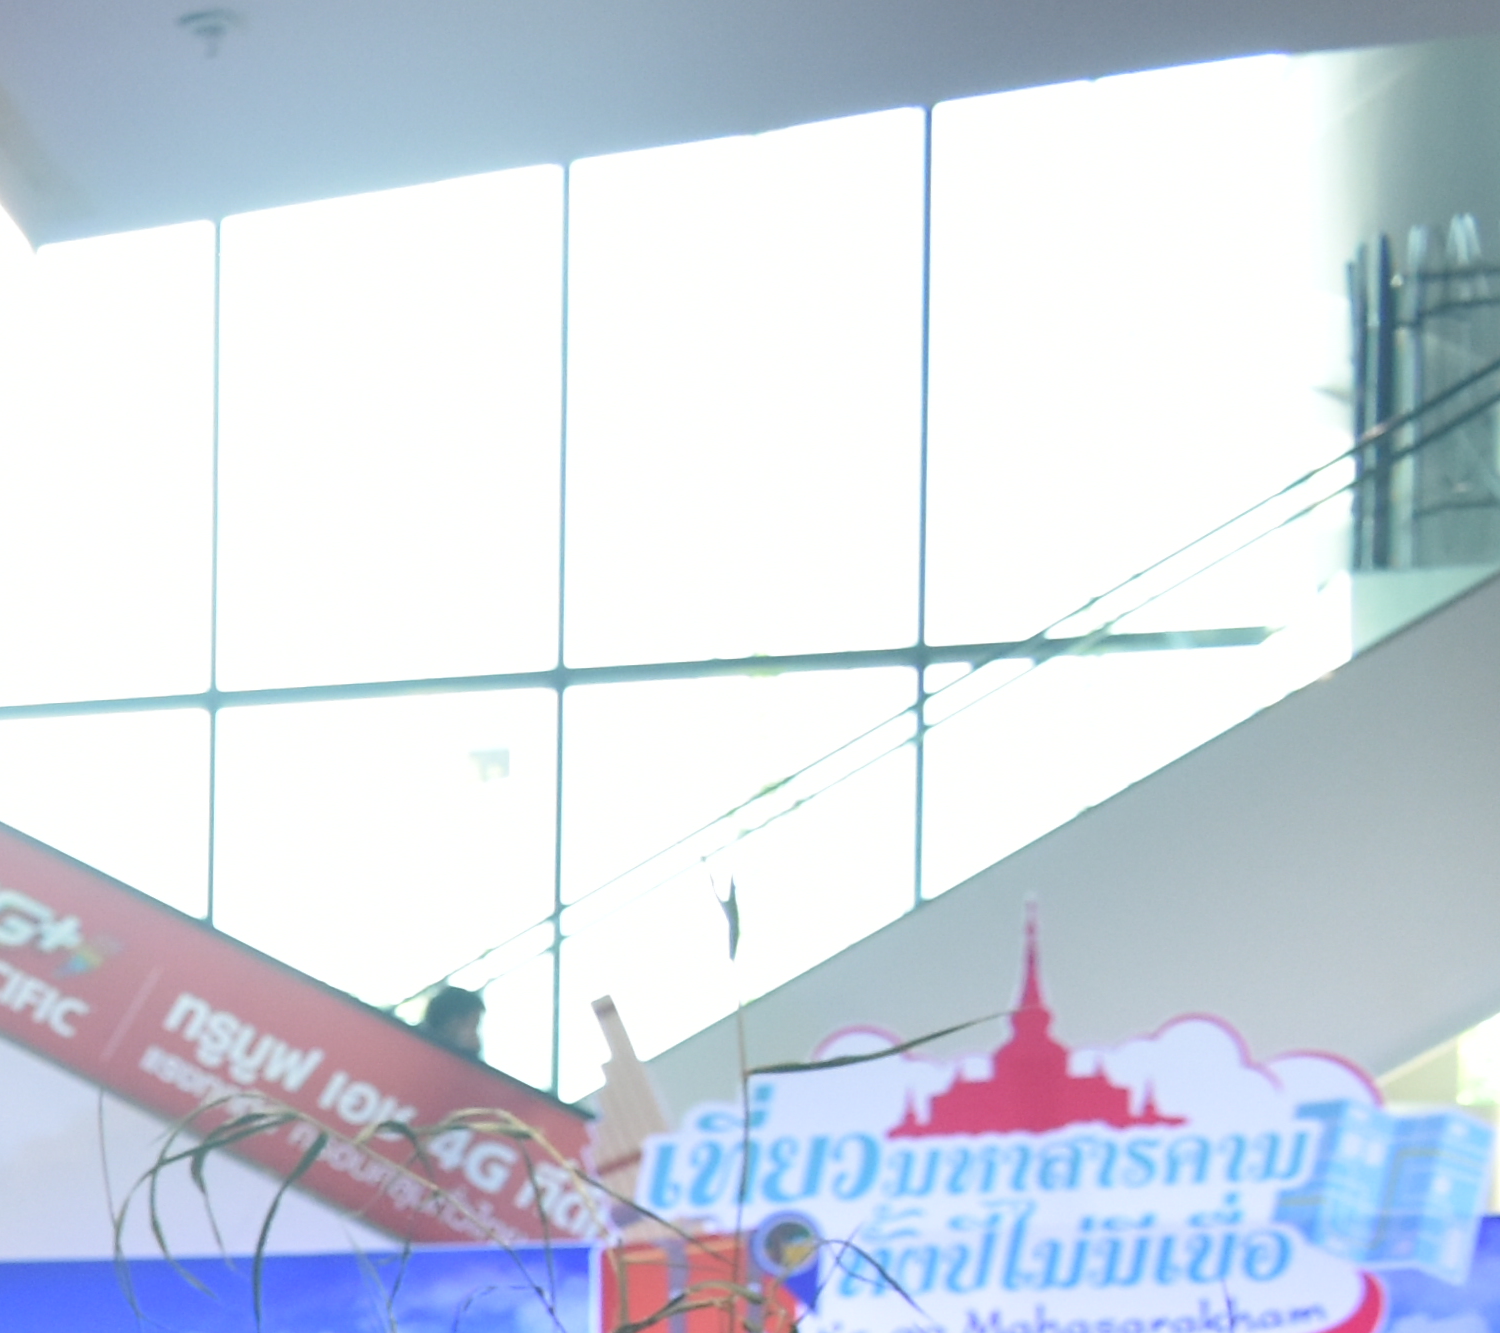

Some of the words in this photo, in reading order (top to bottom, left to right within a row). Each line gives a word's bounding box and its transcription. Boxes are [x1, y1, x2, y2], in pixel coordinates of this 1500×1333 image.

[162, 992, 326, 1091] ทรูมูฟ
[428, 1127, 519, 1193] 4G
